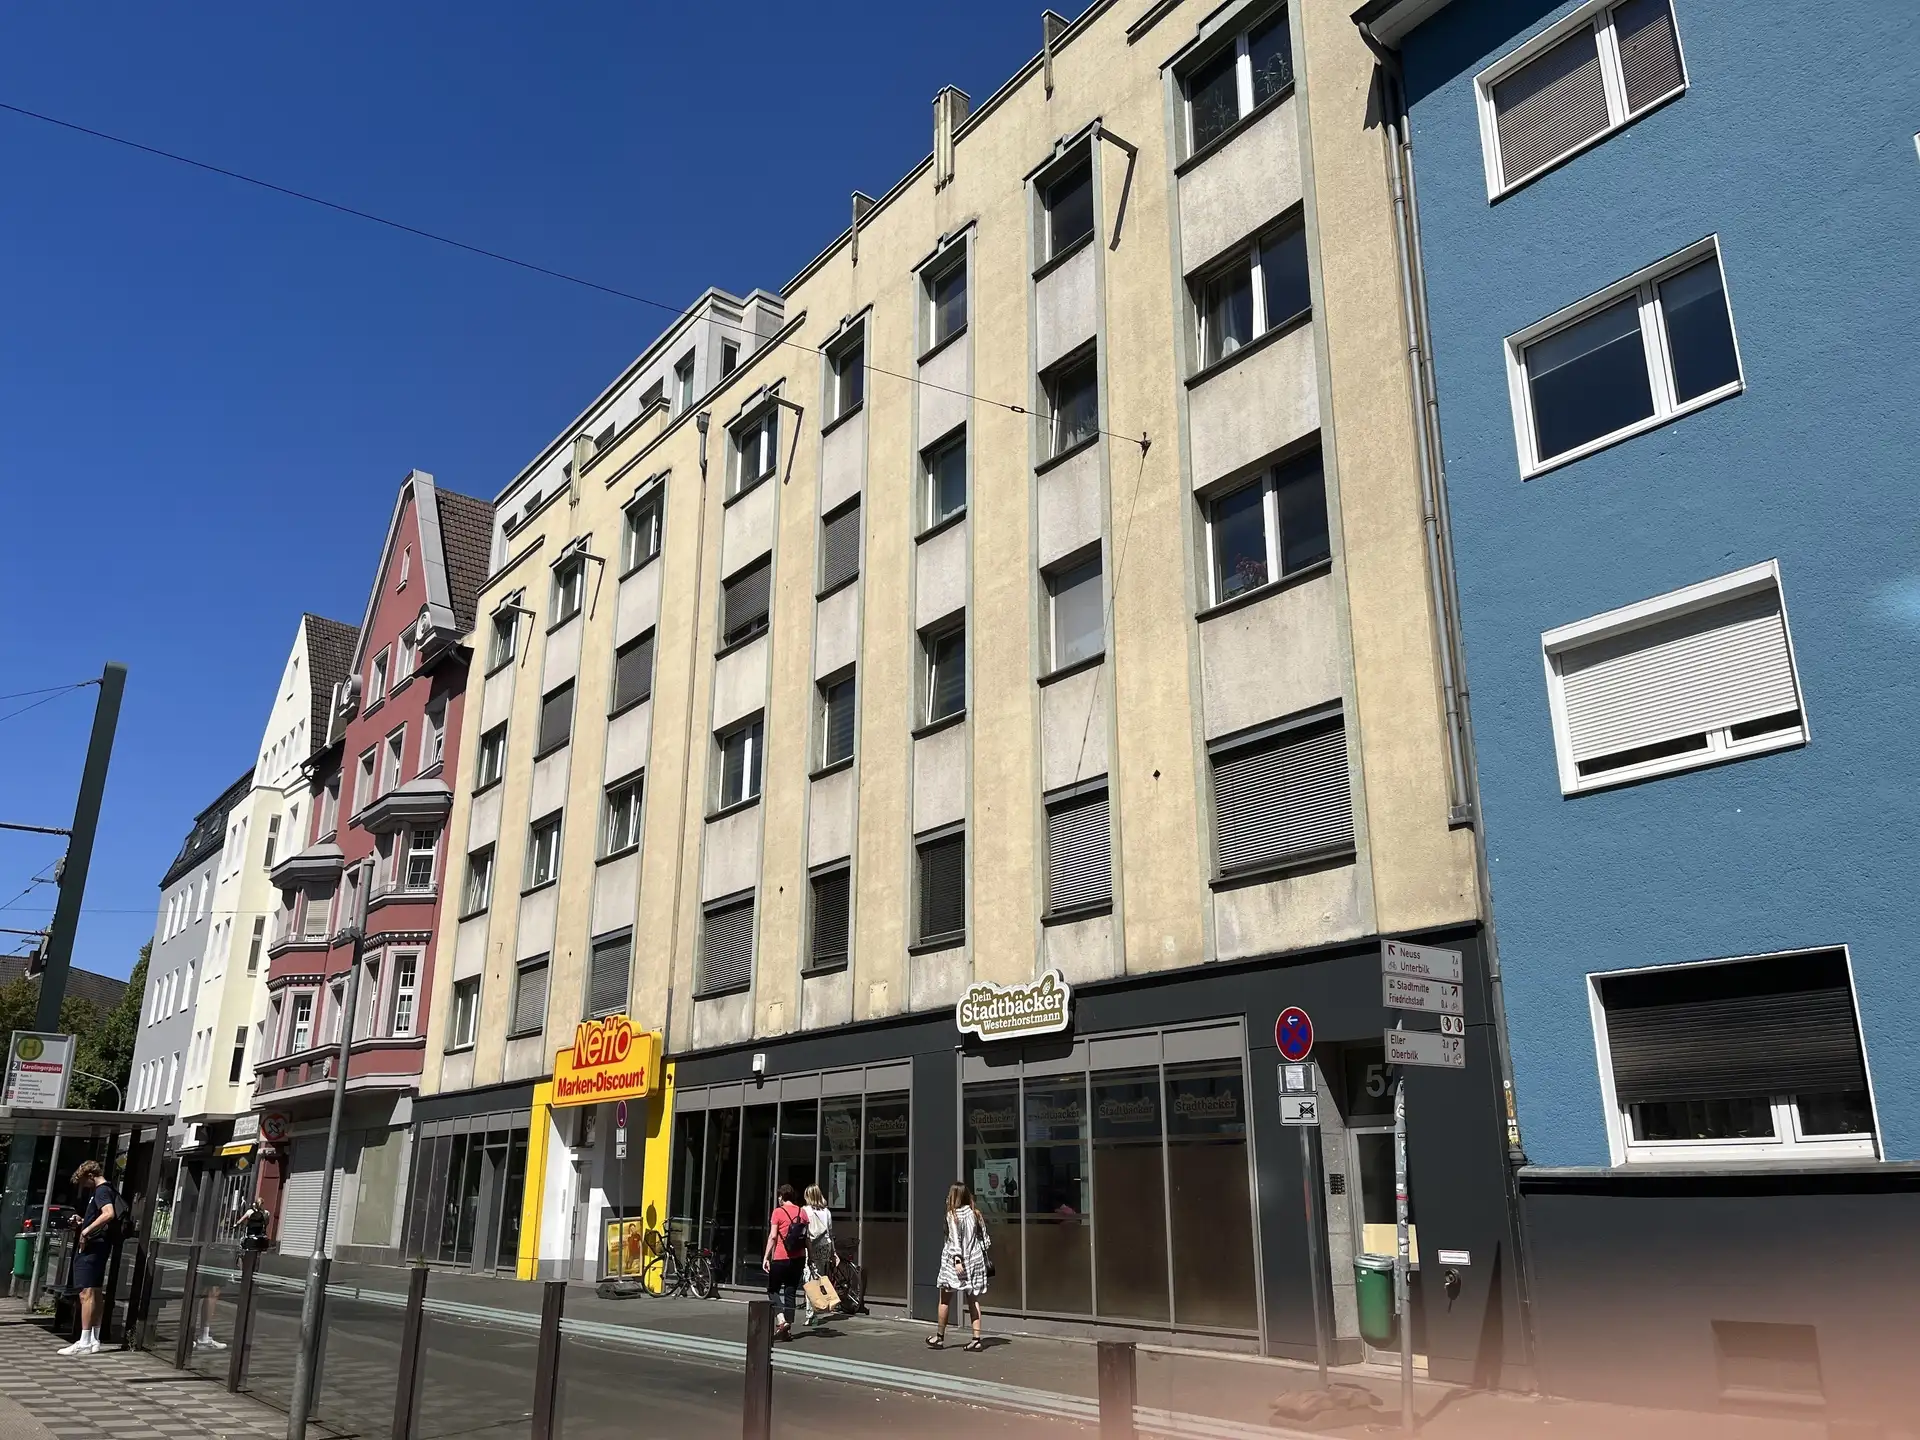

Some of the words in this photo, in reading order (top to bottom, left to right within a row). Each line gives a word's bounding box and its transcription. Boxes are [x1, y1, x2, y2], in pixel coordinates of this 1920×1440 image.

[1400, 948, 1421, 960] Neuss
[1400, 961, 1431, 974] Unterbilk
[1396, 980, 1430, 994] Stadtmitte
[972, 990, 992, 1004] Dein
[1388, 992, 1425, 1007] Friedrichstadt
[962, 991, 1062, 1023] Stadtbäcker
[983, 1011, 1061, 1031] Westerhorstmann
[572, 1016, 632, 1070] Netto
[1390, 1034, 1407, 1045] Eller
[22, 1040, 38, 1056] H
[1391, 1048, 1419, 1061] Oberbilk
[21, 1063, 62, 1073] Karolingerplatz
[557, 1066, 645, 1098] Marken-Discount
